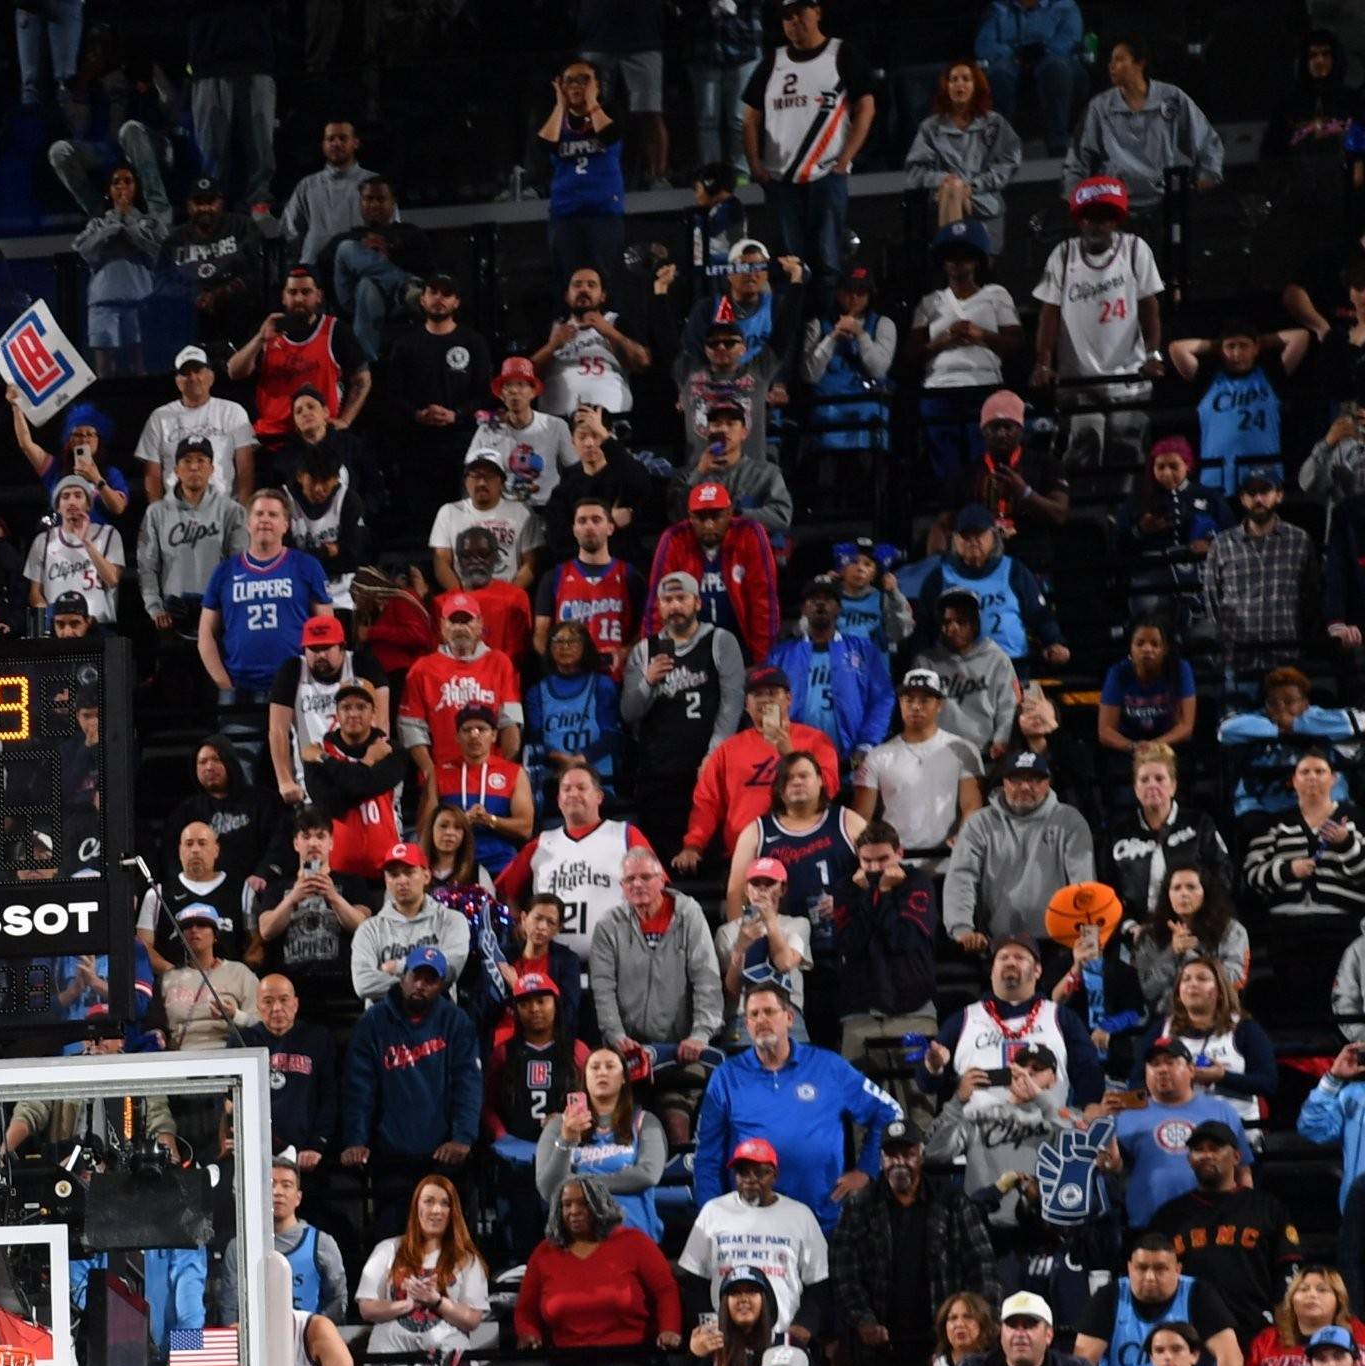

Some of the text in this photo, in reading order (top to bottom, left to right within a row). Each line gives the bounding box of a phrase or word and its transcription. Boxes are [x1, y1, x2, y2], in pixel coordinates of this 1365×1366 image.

[782, 75, 798, 95] 2
[575, 157, 588, 175] 2
[1098, 300, 1128, 324] 24
[578, 356, 605, 377] 55
[168, 519, 220, 548] Clips
[231, 579, 294, 604] CLIPPERS
[246, 603, 278, 631] 23
[684, 691, 702, 720] 2
[816, 859, 830, 887] 1
[382, 1036, 447, 1070] Clippers
[530, 1091, 548, 1119] 2
